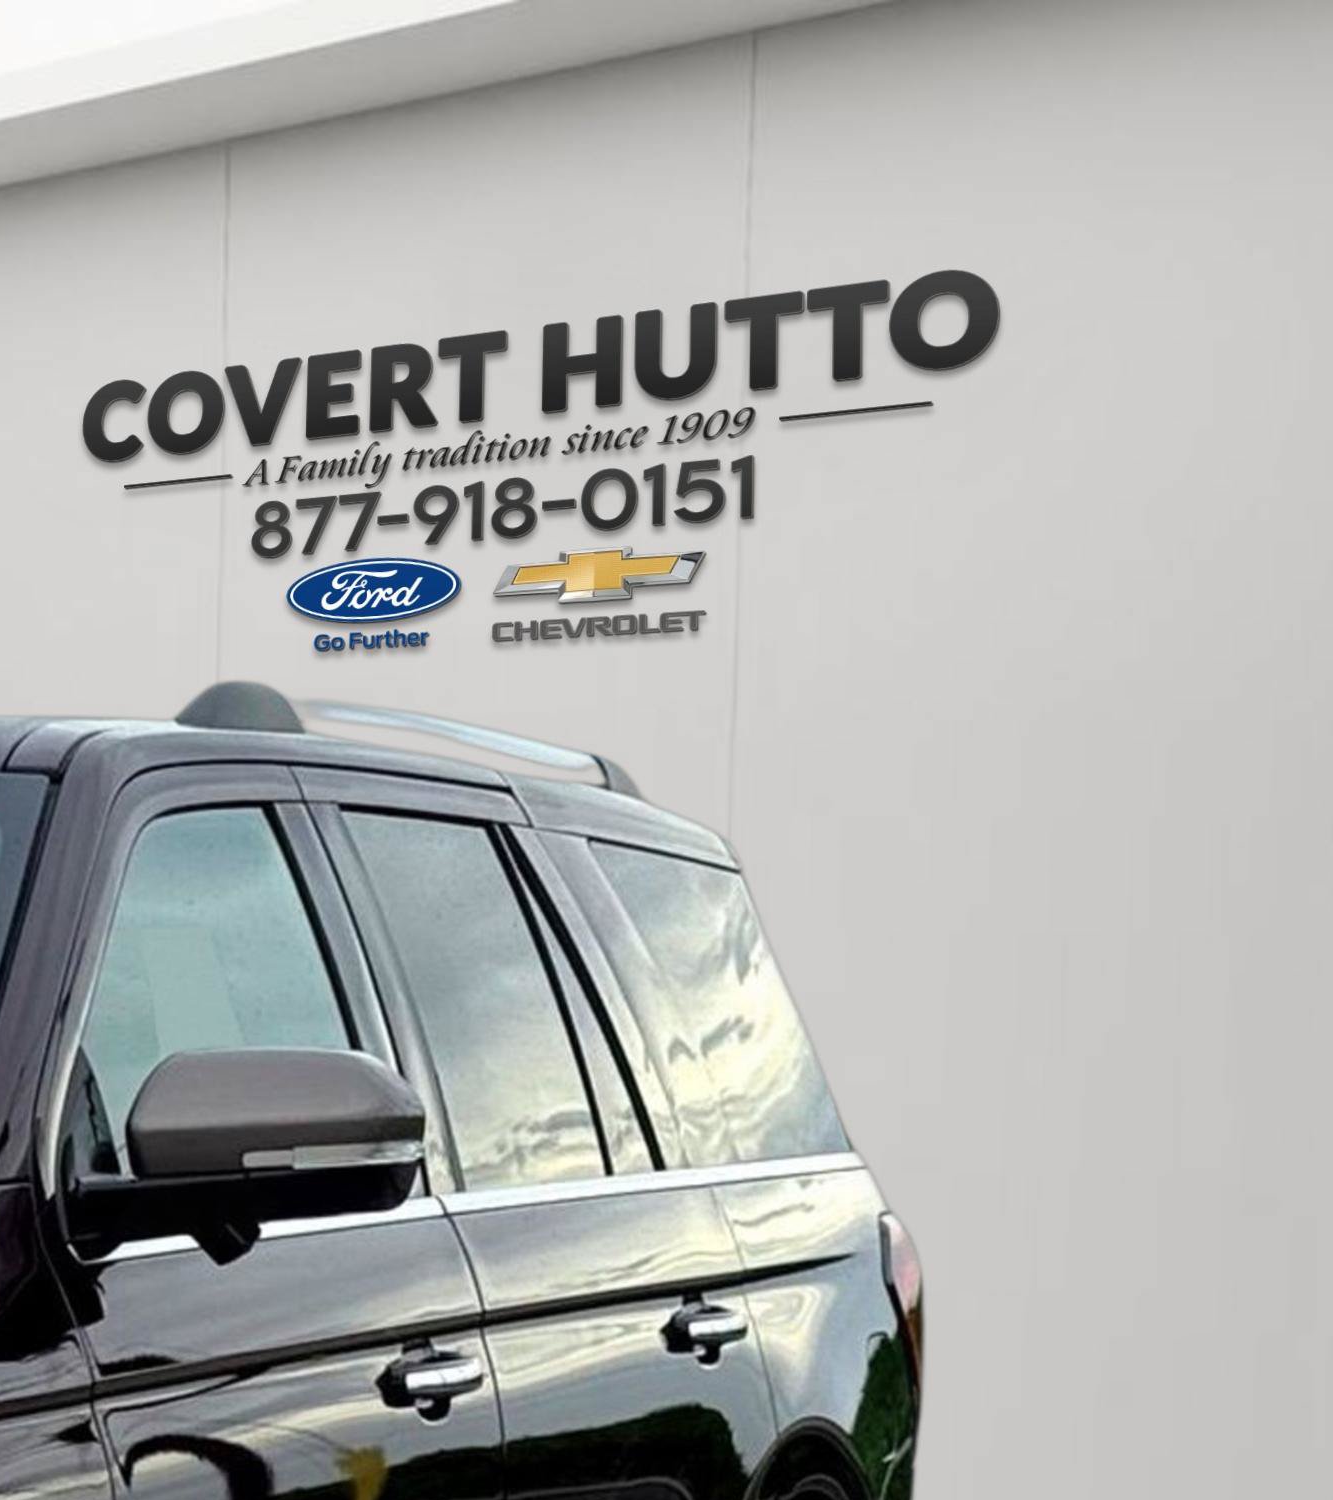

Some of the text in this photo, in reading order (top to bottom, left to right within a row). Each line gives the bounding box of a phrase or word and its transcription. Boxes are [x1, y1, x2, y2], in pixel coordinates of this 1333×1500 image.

[82, 269, 1001, 464] COVERT HUTTO
[243, 406, 756, 489] A Family tradition since 1909
[251, 454, 755, 560] 877-918-0151
[321, 568, 424, 612] Ford
[313, 628, 430, 653] Go Further
[491, 610, 707, 643] CHEVROLET
